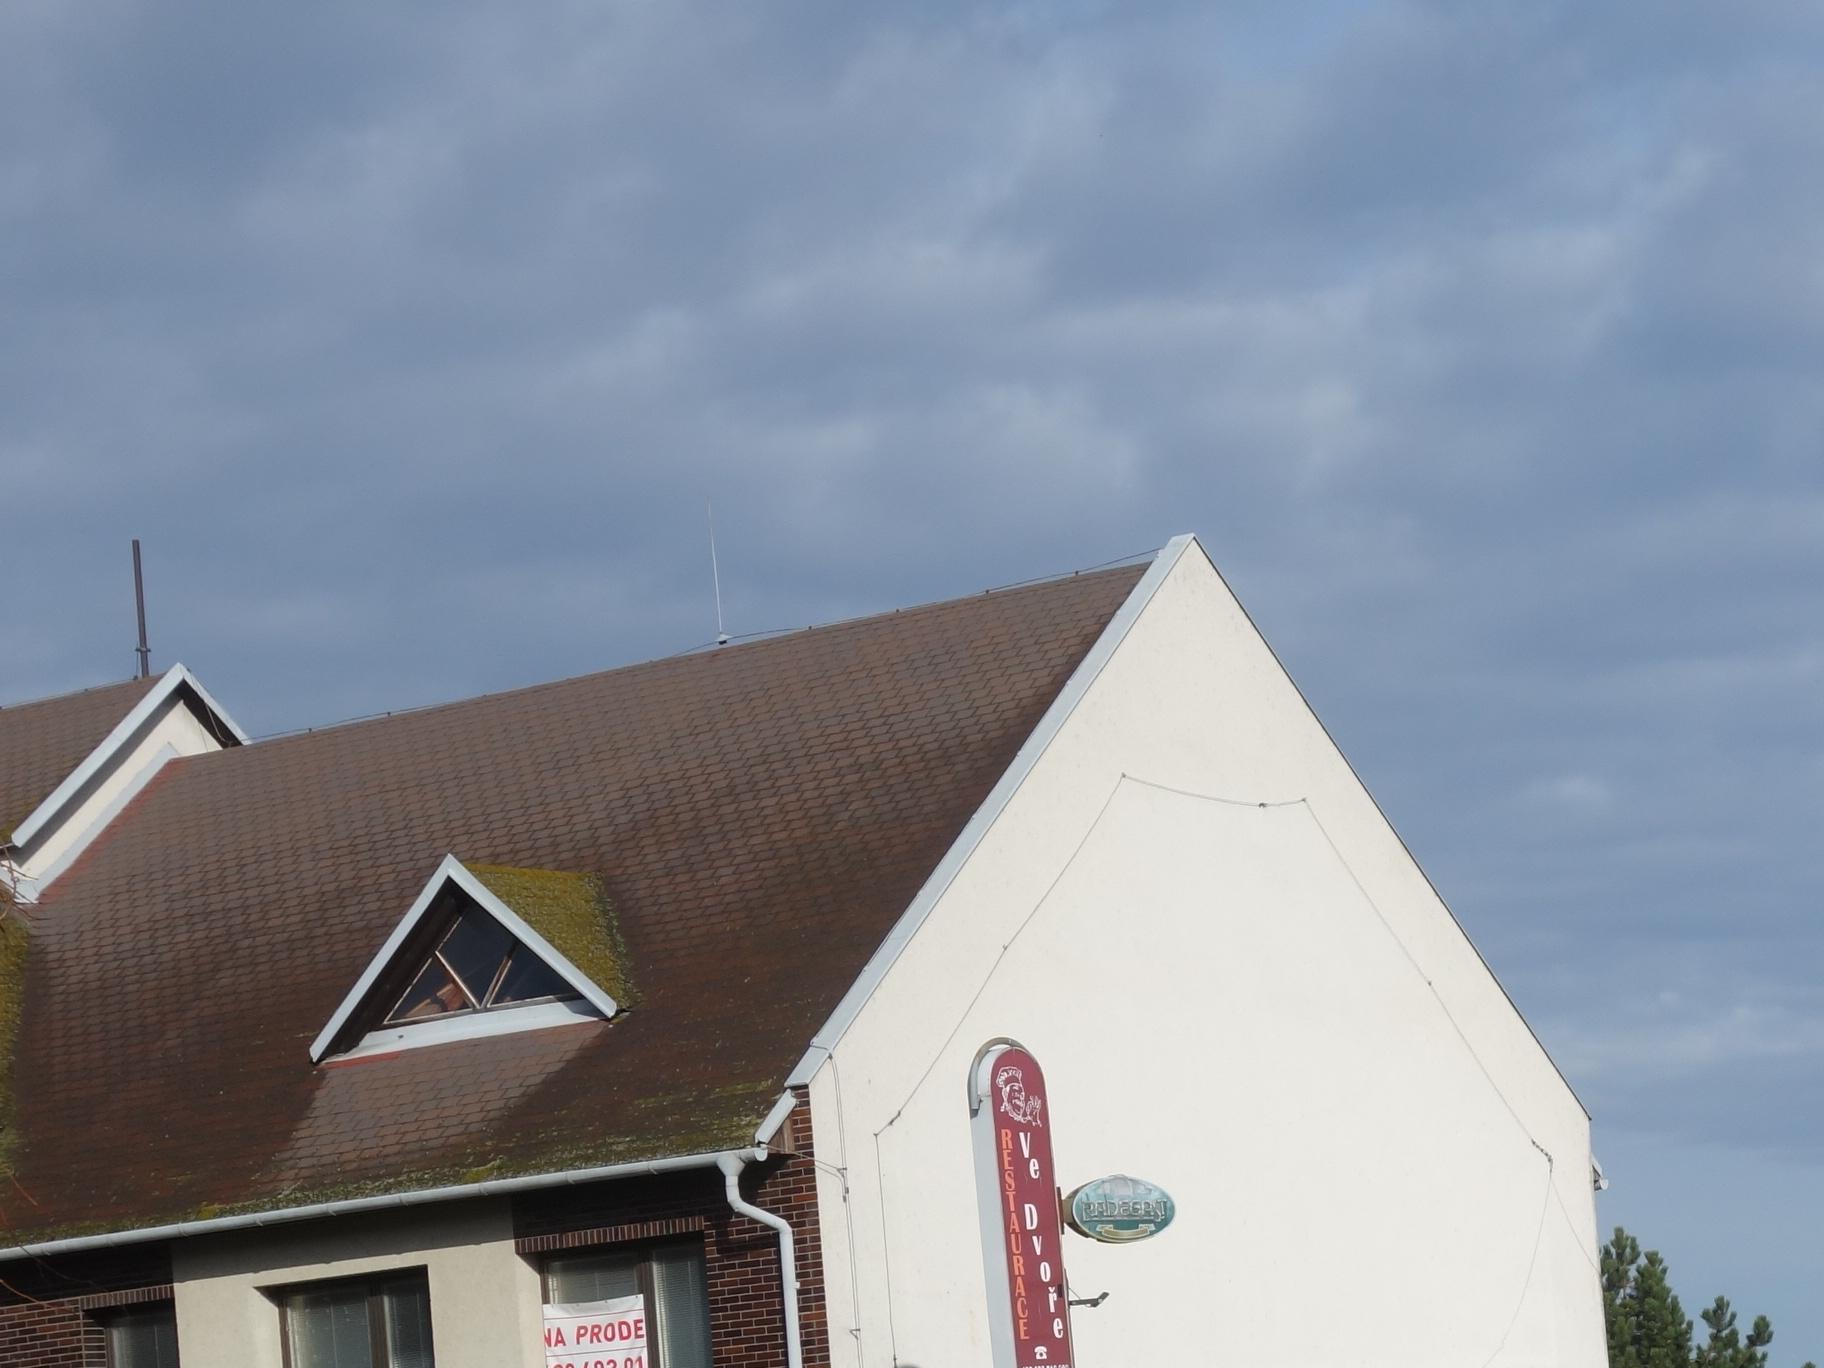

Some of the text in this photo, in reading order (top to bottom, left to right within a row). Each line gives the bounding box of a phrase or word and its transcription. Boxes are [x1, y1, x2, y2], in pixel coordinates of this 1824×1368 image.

[544, 1327, 566, 1347] NA
[1000, 1129, 1029, 1340] RESTAURACE
[1019, 1131, 1063, 1339] Ve Dvoře
